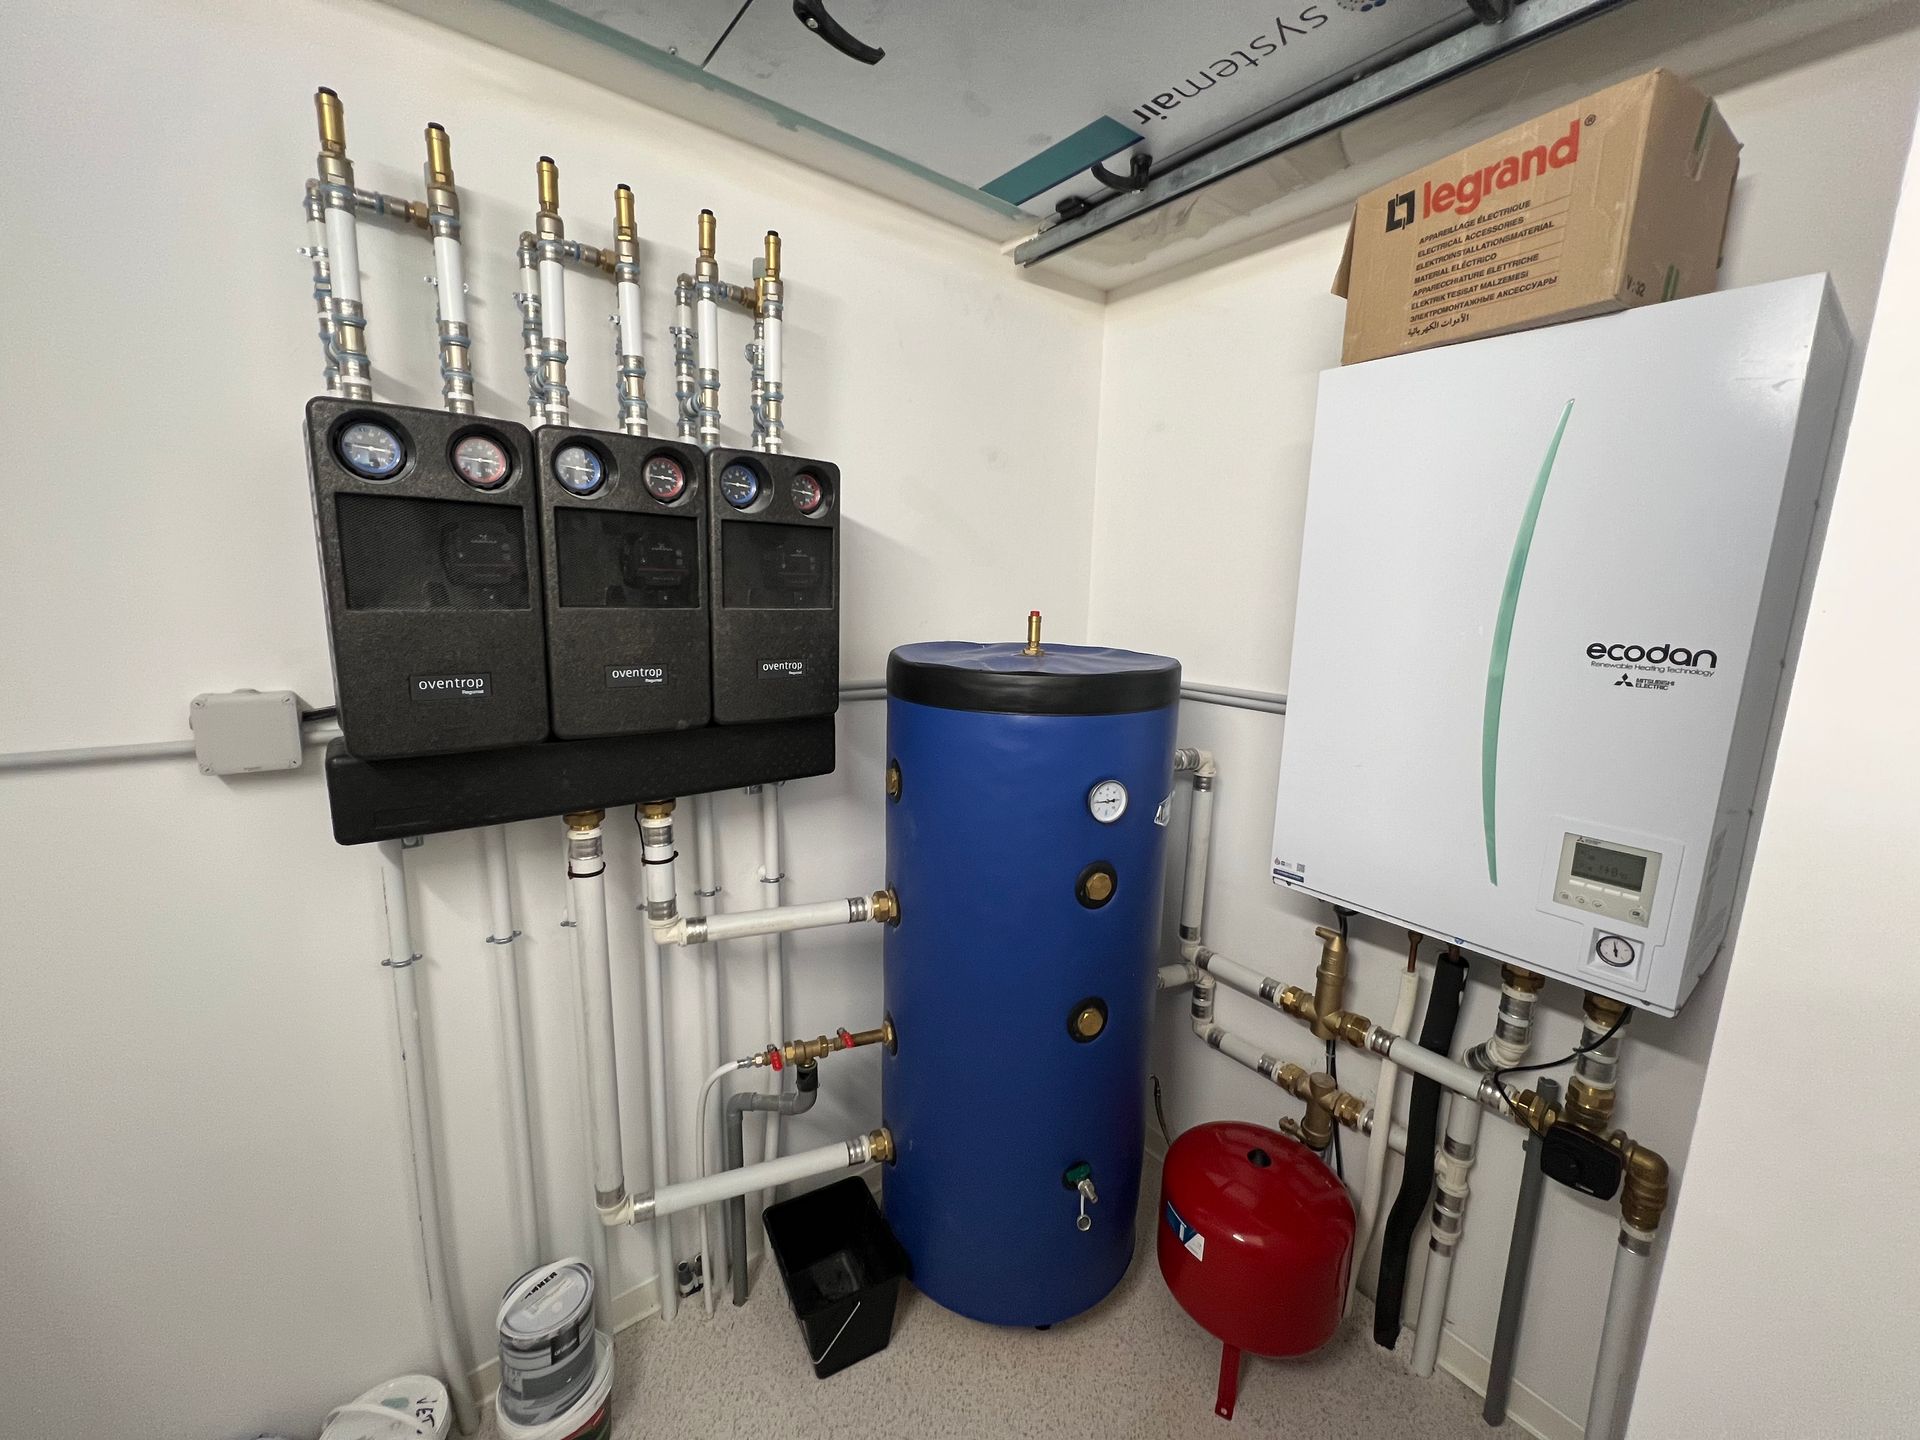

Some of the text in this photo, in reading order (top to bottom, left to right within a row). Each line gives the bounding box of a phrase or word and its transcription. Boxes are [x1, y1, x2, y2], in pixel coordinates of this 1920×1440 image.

[1133, 5, 1329, 125] systemair
[1423, 118, 1580, 219] legrand
[1419, 200, 1531, 245] APPAREILLAGE ÉLECTRIQUE
[1416, 221, 1555, 271] ELEKTROINSTALLATIONSMATERIAL
[1417, 217, 1524, 258] ELECTRICAL ACCESSORIES
[1412, 253, 1540, 297] APPARECCHIATURE ELETTRICHE
[1414, 252, 1497, 284] MATERIAL ELÉCTRICO
[1411, 291, 1447, 311] ELEKTRIK
[1496, 276, 1558, 300] АКСЕССУАРЫ
[763, 661, 803, 671] oventrop
[1586, 643, 1717, 669] ecodan
[1591, 660, 1715, 678] Renewable Heating Technology
[418, 678, 484, 691] oventrop
[612, 667, 663, 679] oventrop
[1635, 683, 1669, 691] ELECTRIC
